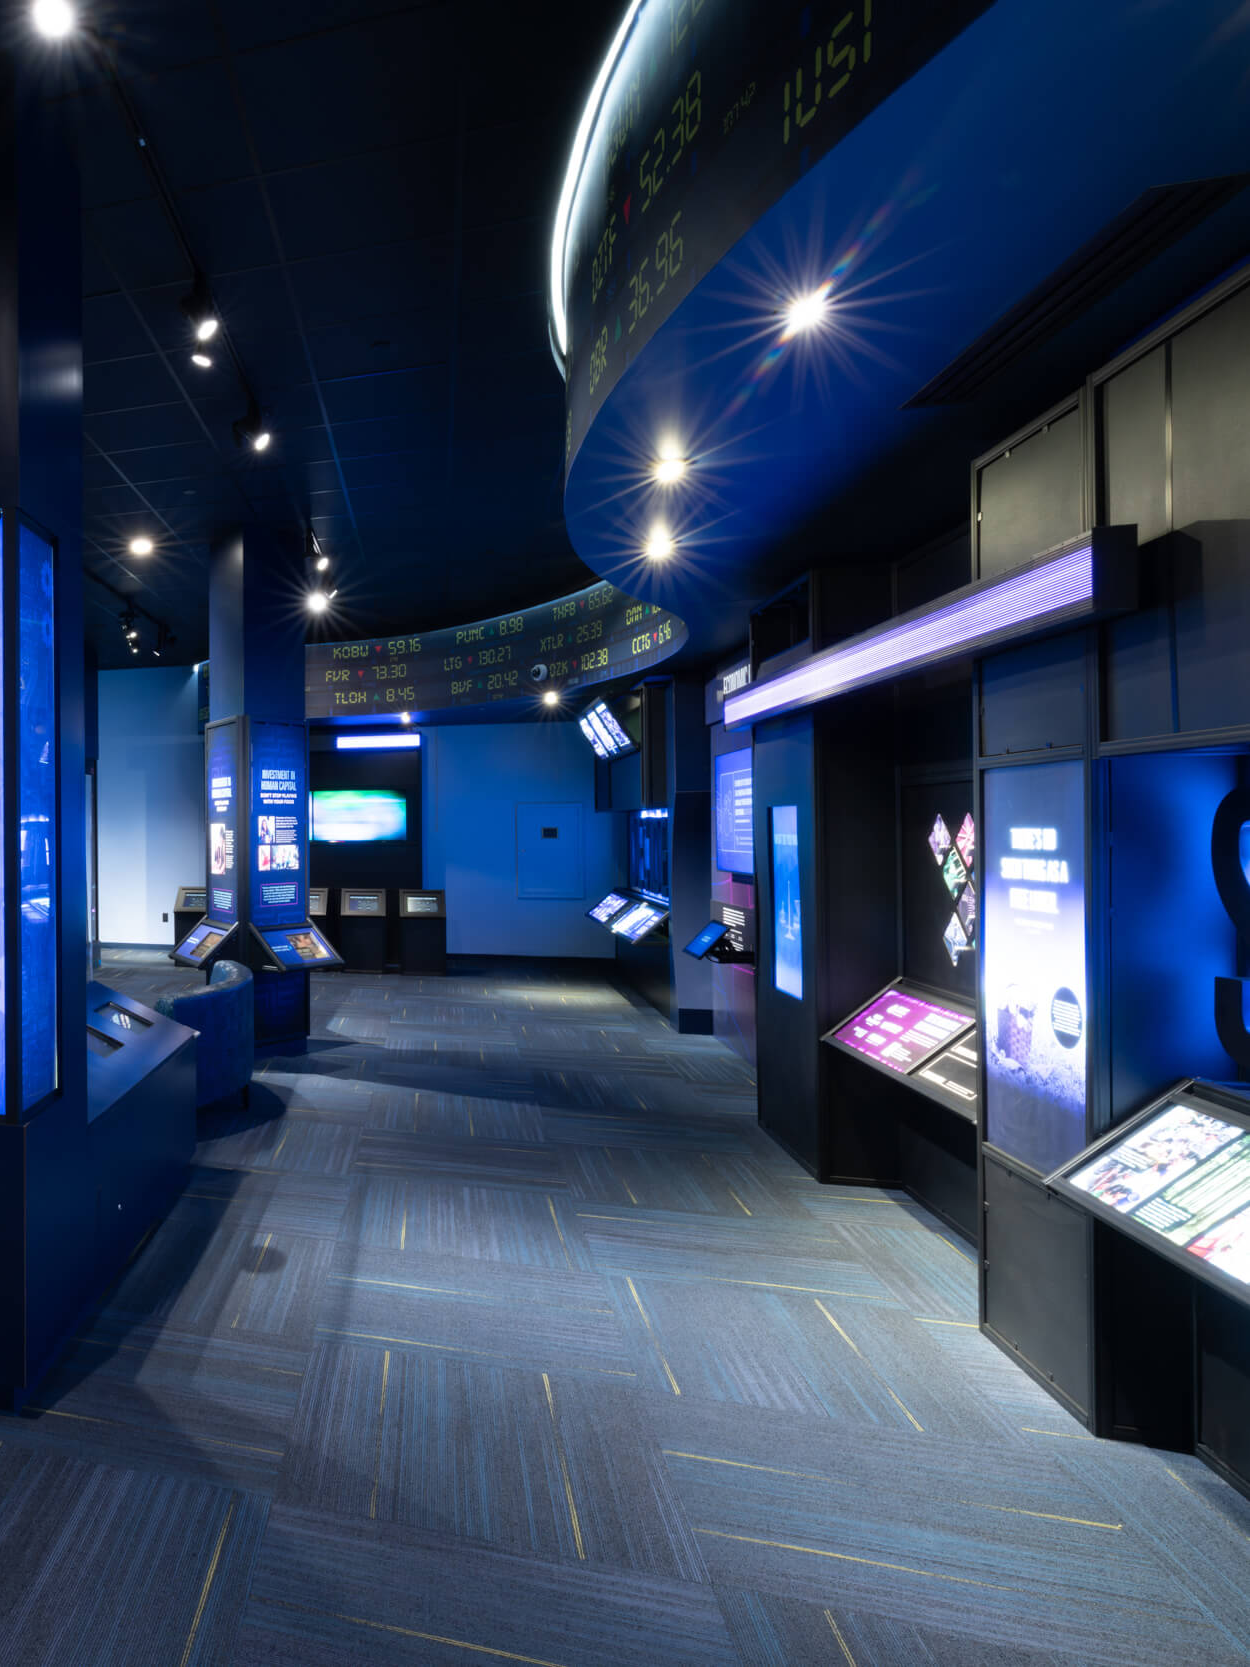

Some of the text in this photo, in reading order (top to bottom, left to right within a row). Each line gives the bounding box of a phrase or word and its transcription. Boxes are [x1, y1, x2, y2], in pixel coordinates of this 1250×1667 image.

[639, 70, 701, 213] 52.38
[388, 638, 422, 655] 59.16
[371, 664, 407, 680] 73.30
[386, 686, 414, 702] 8.45
